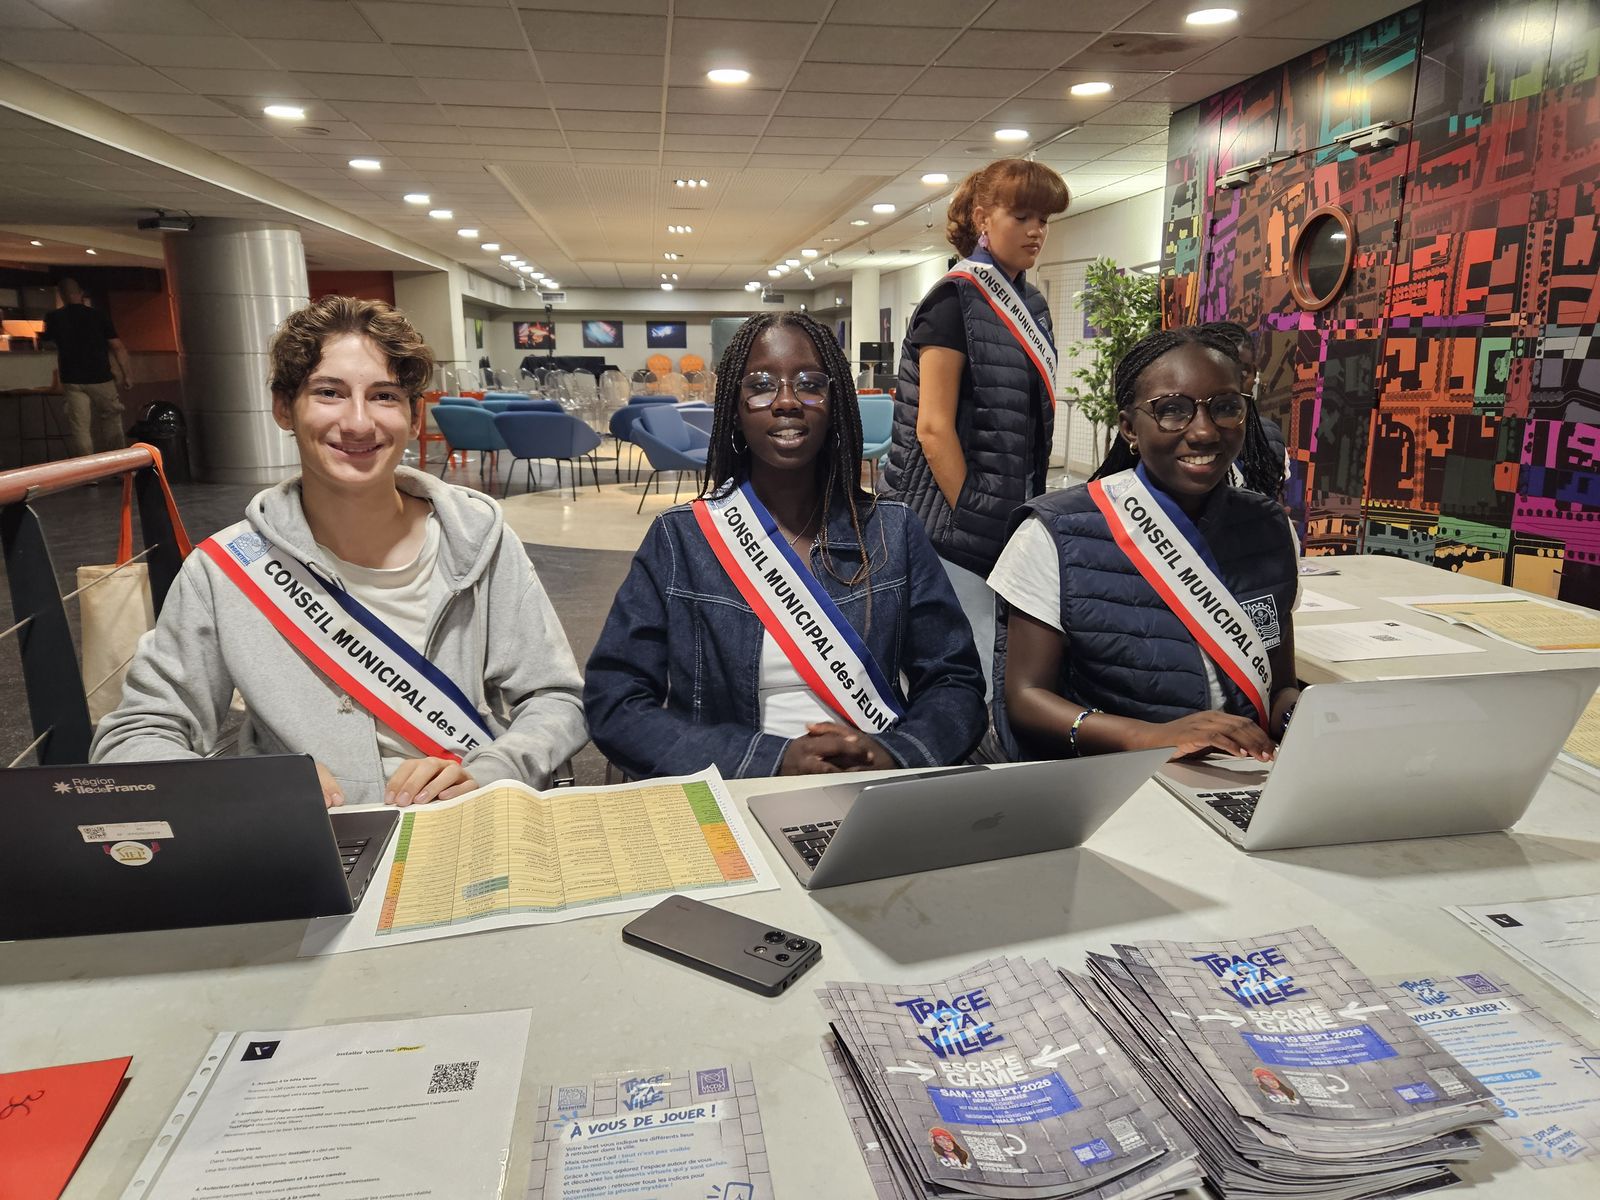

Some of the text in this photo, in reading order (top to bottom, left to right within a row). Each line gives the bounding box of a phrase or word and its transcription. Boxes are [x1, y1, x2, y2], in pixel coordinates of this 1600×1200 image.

[973, 265, 1010, 308] CONSEIL
[1009, 303, 1046, 358] MUNICIPAL
[722, 506, 770, 571] CONSEIL
[762, 567, 835, 662] MUNICIPAL
[829, 658, 855, 691] des
[1123, 496, 1269, 685] CONSEIL MUNICIPAL des
[263, 559, 336, 634] CONSEIL
[331, 627, 428, 714] MUNICIPAL
[426, 708, 457, 737] des
[72, 778, 115, 788] Région
[1191, 947, 1287, 978] TRACE
[894, 987, 992, 1024] TRACE
[1220, 975, 1308, 1009] VILLE
[1245, 1004, 1327, 1022] ESCAPE
[1254, 1015, 1340, 1034] GAME
[1410, 1009, 1442, 1024] VOUS
[1442, 1007, 1463, 1019] DE
[1464, 1002, 1503, 1016] JOUER
[917, 1022, 1005, 1059] VILLE
[1252, 1033, 1284, 1045] SAM.
[939, 1054, 1022, 1074] ESCAPE
[945, 1064, 1030, 1088] GAME
[939, 1078, 1052, 1100] SAM. 19 SEPT. 2026
[570, 1103, 716, 1140] À VOUS DE JOUER !
